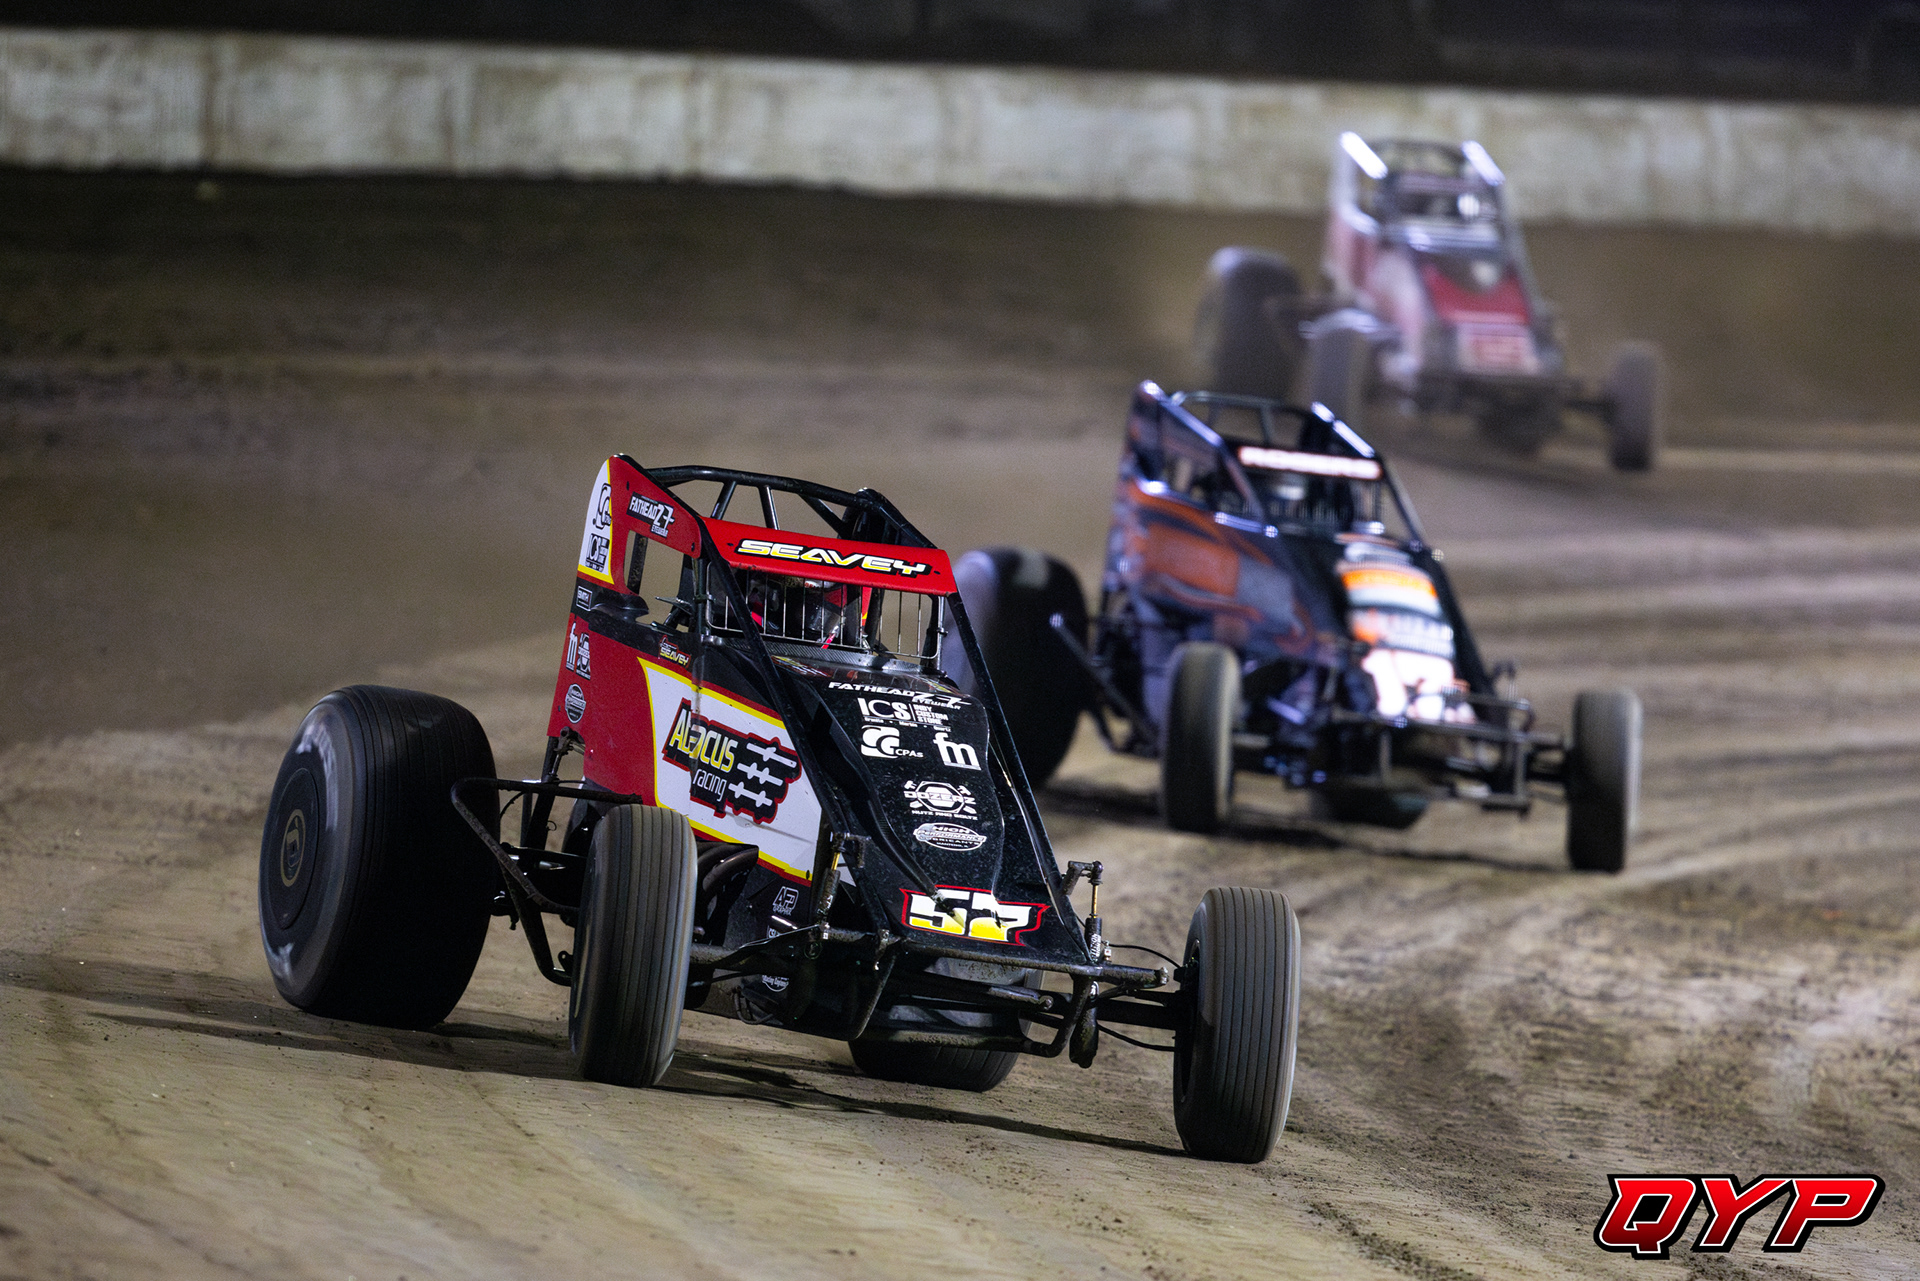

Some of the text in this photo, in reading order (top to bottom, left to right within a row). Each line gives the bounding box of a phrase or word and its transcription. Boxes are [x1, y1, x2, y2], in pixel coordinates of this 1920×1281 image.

[737, 539, 928, 575] SEAVEY
[660, 646, 689, 665] SEAVEY
[857, 697, 912, 721] ICS
[693, 768, 727, 802] racing
